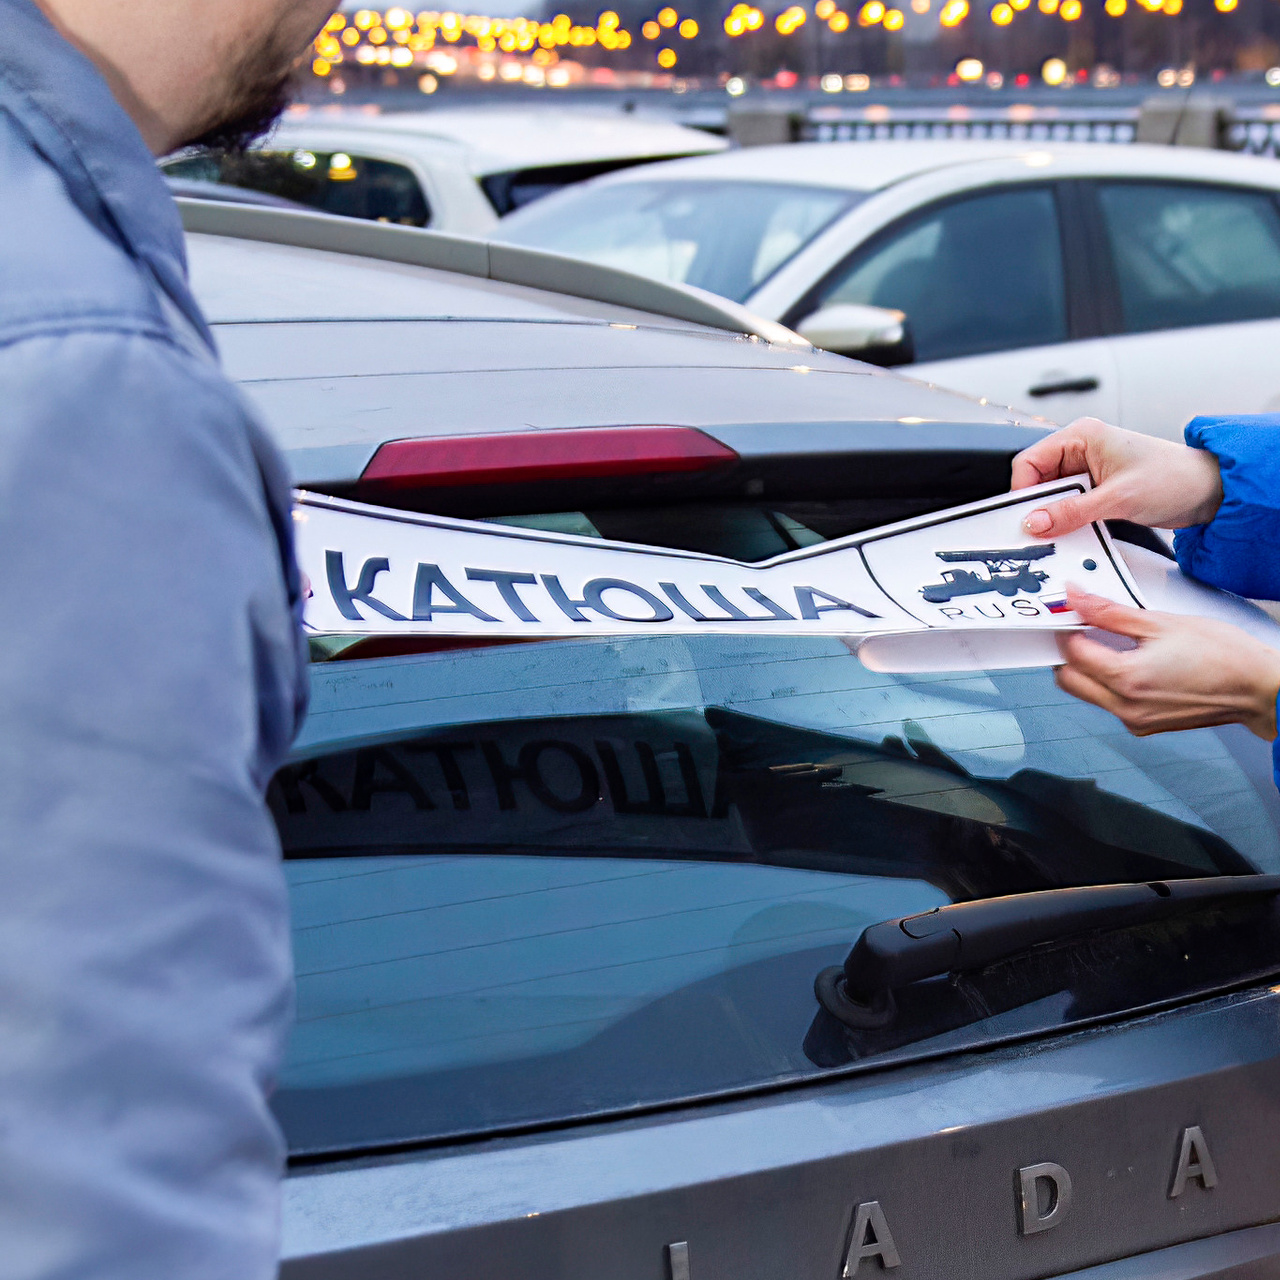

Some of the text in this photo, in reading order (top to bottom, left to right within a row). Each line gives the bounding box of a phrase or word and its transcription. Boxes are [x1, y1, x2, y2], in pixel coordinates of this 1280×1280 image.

[324, 548, 885, 623] КАТЮША
[937, 598, 1041, 620] RUS
[274, 739, 729, 818] КАТЮШ
